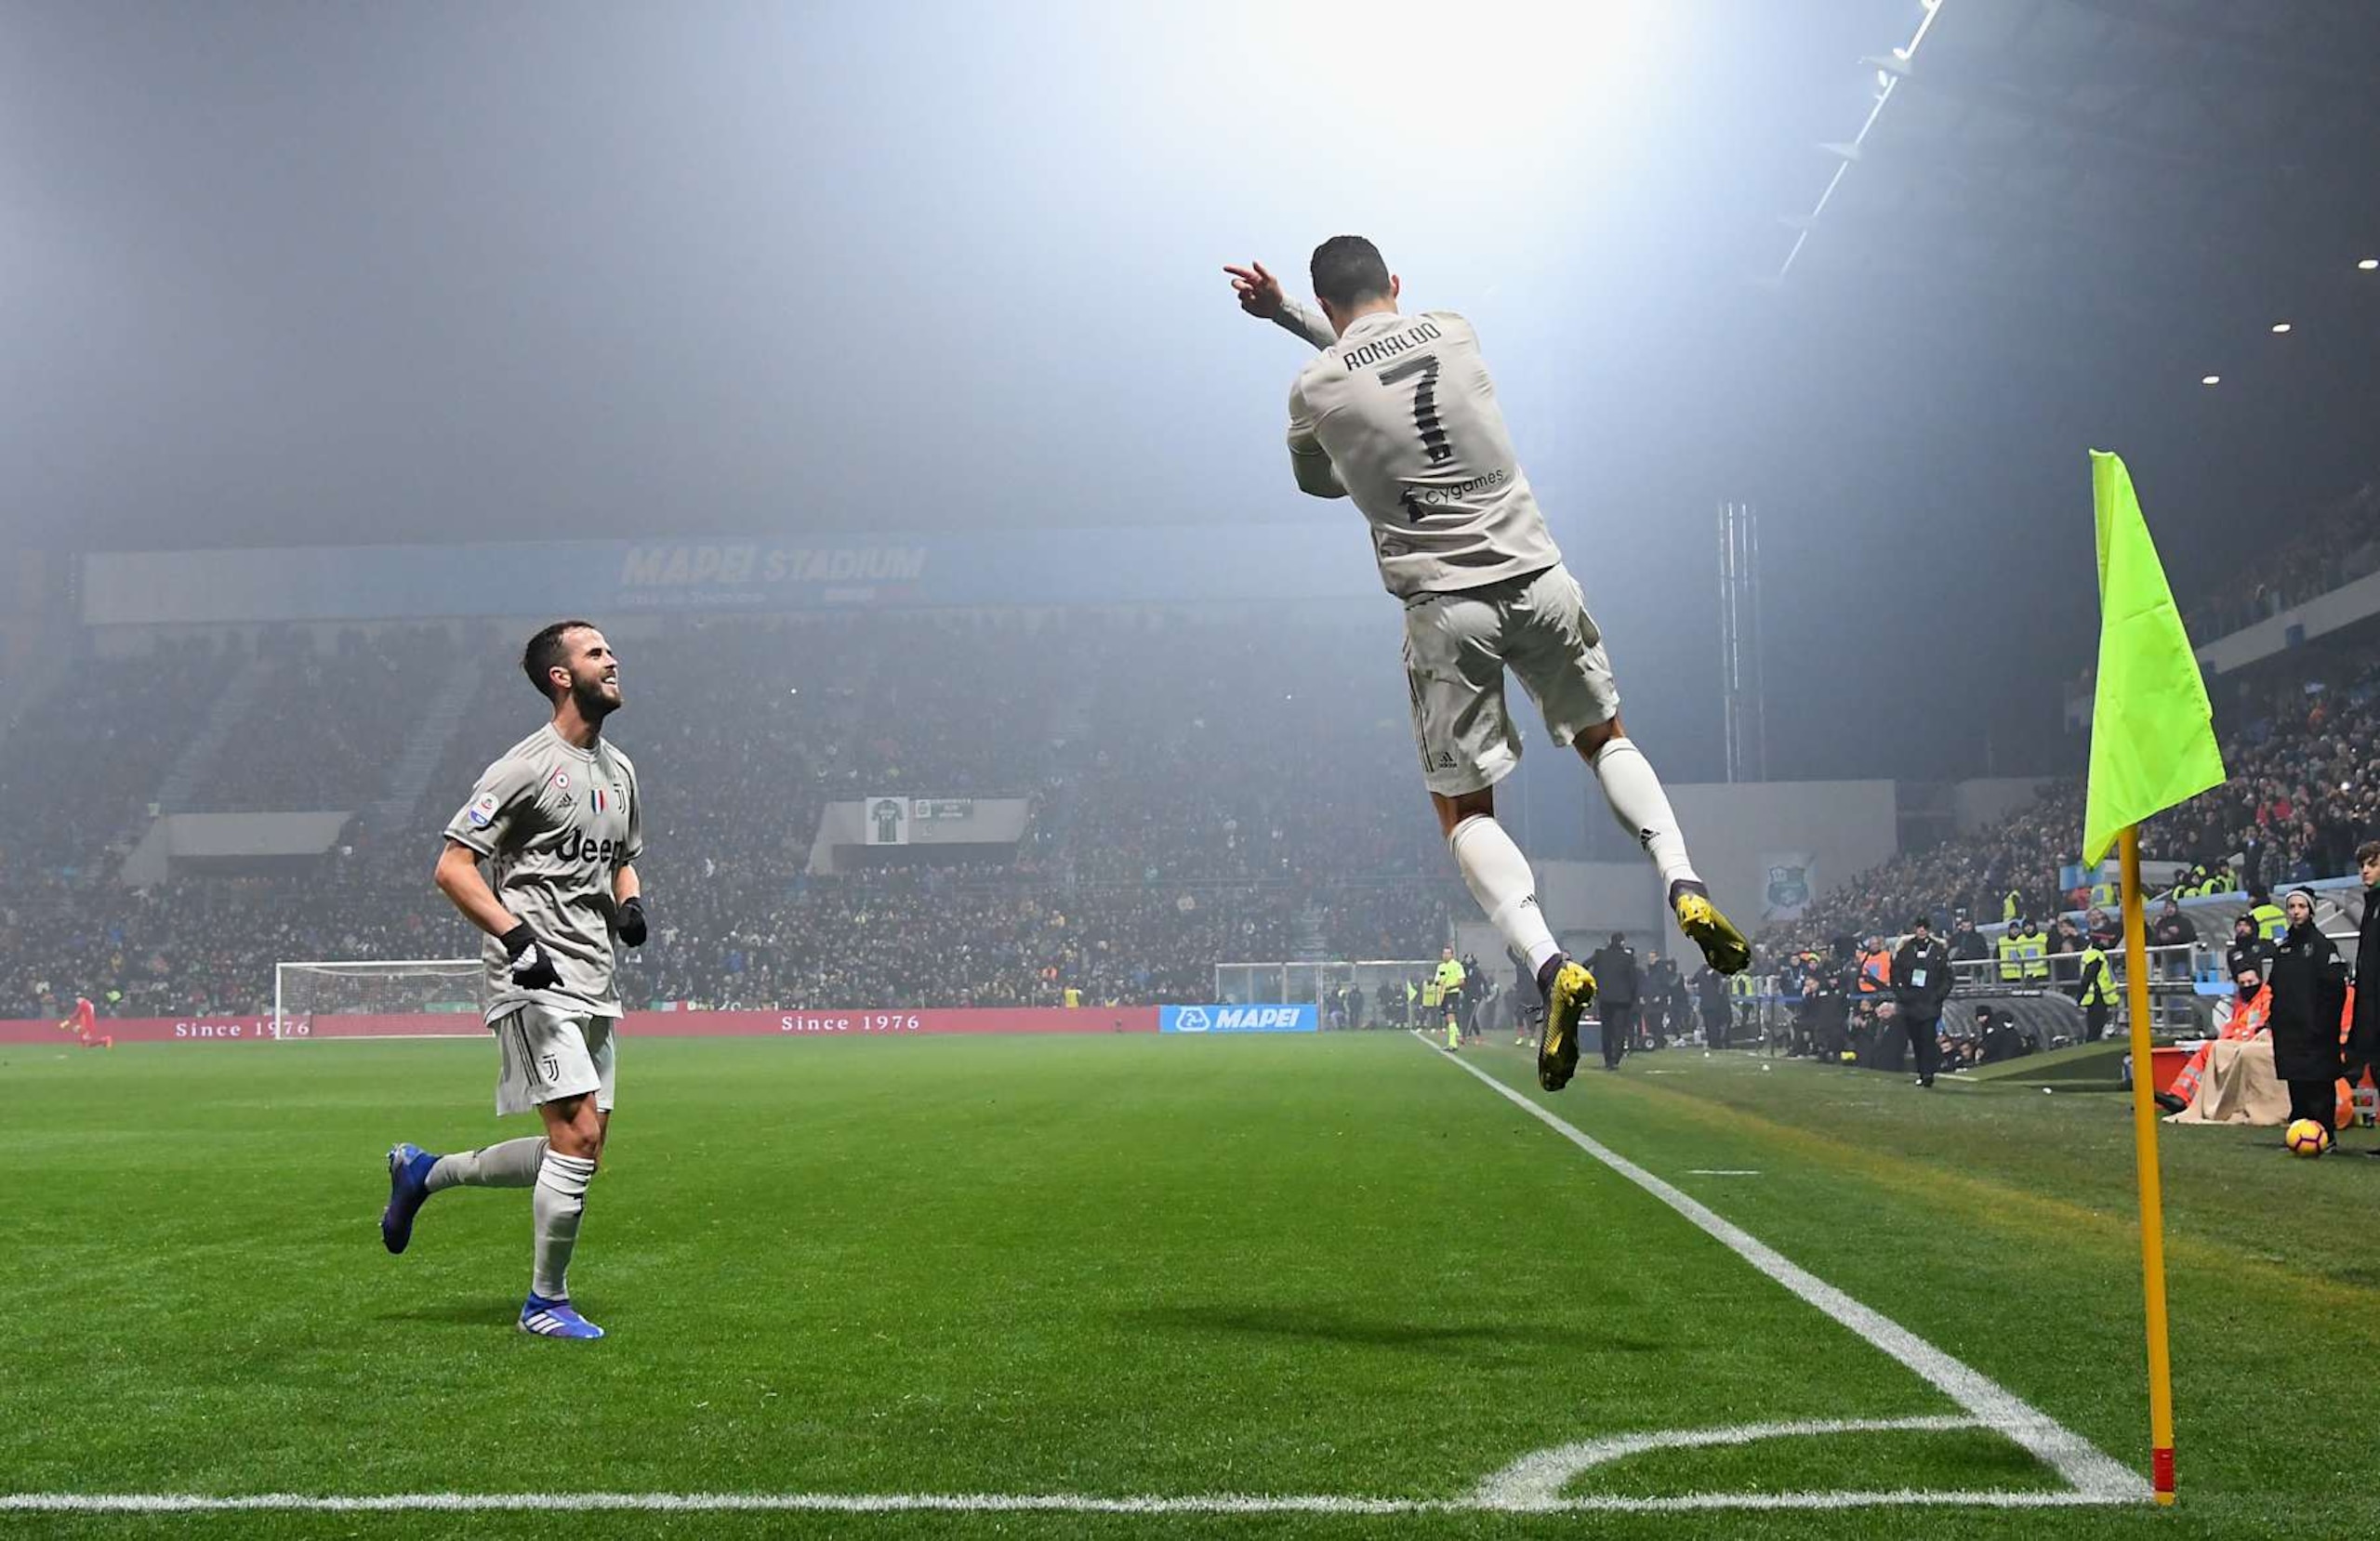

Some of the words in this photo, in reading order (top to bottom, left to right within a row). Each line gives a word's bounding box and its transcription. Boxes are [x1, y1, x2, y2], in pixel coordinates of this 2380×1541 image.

[1342, 323, 1441, 371] RONALDO
[1377, 351, 1452, 464] 7
[1425, 468, 1503, 505] Cygames
[622, 546, 758, 584] MAPEI
[764, 547, 927, 583] STADIUM
[175, 1021, 242, 1036] Since
[256, 1021, 311, 1036] 1976
[781, 1016, 849, 1030] Since
[864, 1015, 919, 1030] 1976
[1215, 1008, 1300, 1028] MAPEI
